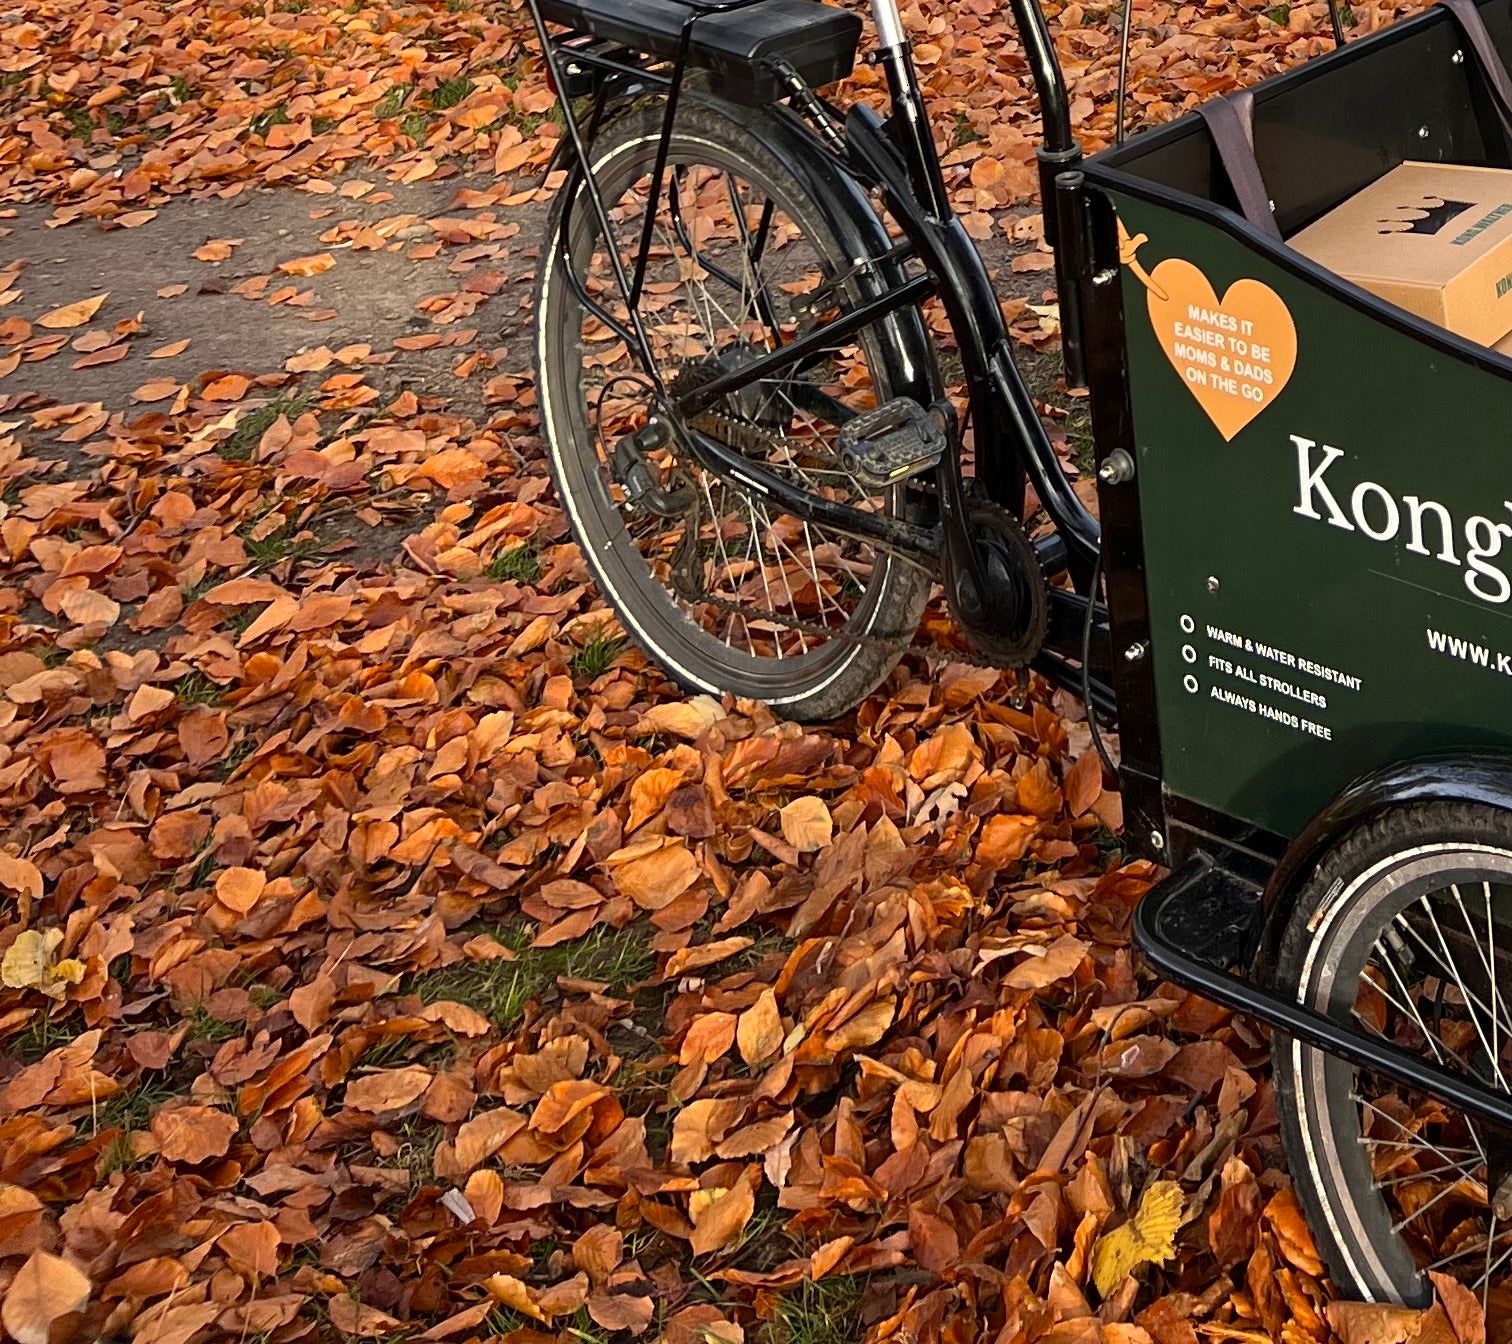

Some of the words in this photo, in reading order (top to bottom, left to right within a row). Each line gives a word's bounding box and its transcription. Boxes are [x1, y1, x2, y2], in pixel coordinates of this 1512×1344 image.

[1188, 304, 1237, 332] MAKES
[1241, 319, 1254, 336] IT
[1174, 321, 1225, 349] EASIER
[1228, 337, 1247, 356] TO
[1251, 344, 1271, 362] BE
[1174, 342, 1216, 368] MOMS
[1220, 356, 1230, 372] &
[1234, 360, 1273, 384] DADS
[1186, 367, 1207, 385] ON
[1210, 373, 1238, 395] THE
[1242, 384, 1263, 402] GO
[1206, 625, 1242, 648] WARM
[1245, 639, 1253, 653] &
[1255, 642, 1296, 668] WATER
[1298, 658, 1363, 692] RESISTANT
[1208, 655, 1232, 674] FITS
[1235, 665, 1258, 684] ALL
[1259, 674, 1327, 709] STROLLERS
[1210, 686, 1256, 713] ALWAYS
[1259, 703, 1299, 728] HANDS
[1301, 719, 1332, 741] FREE
